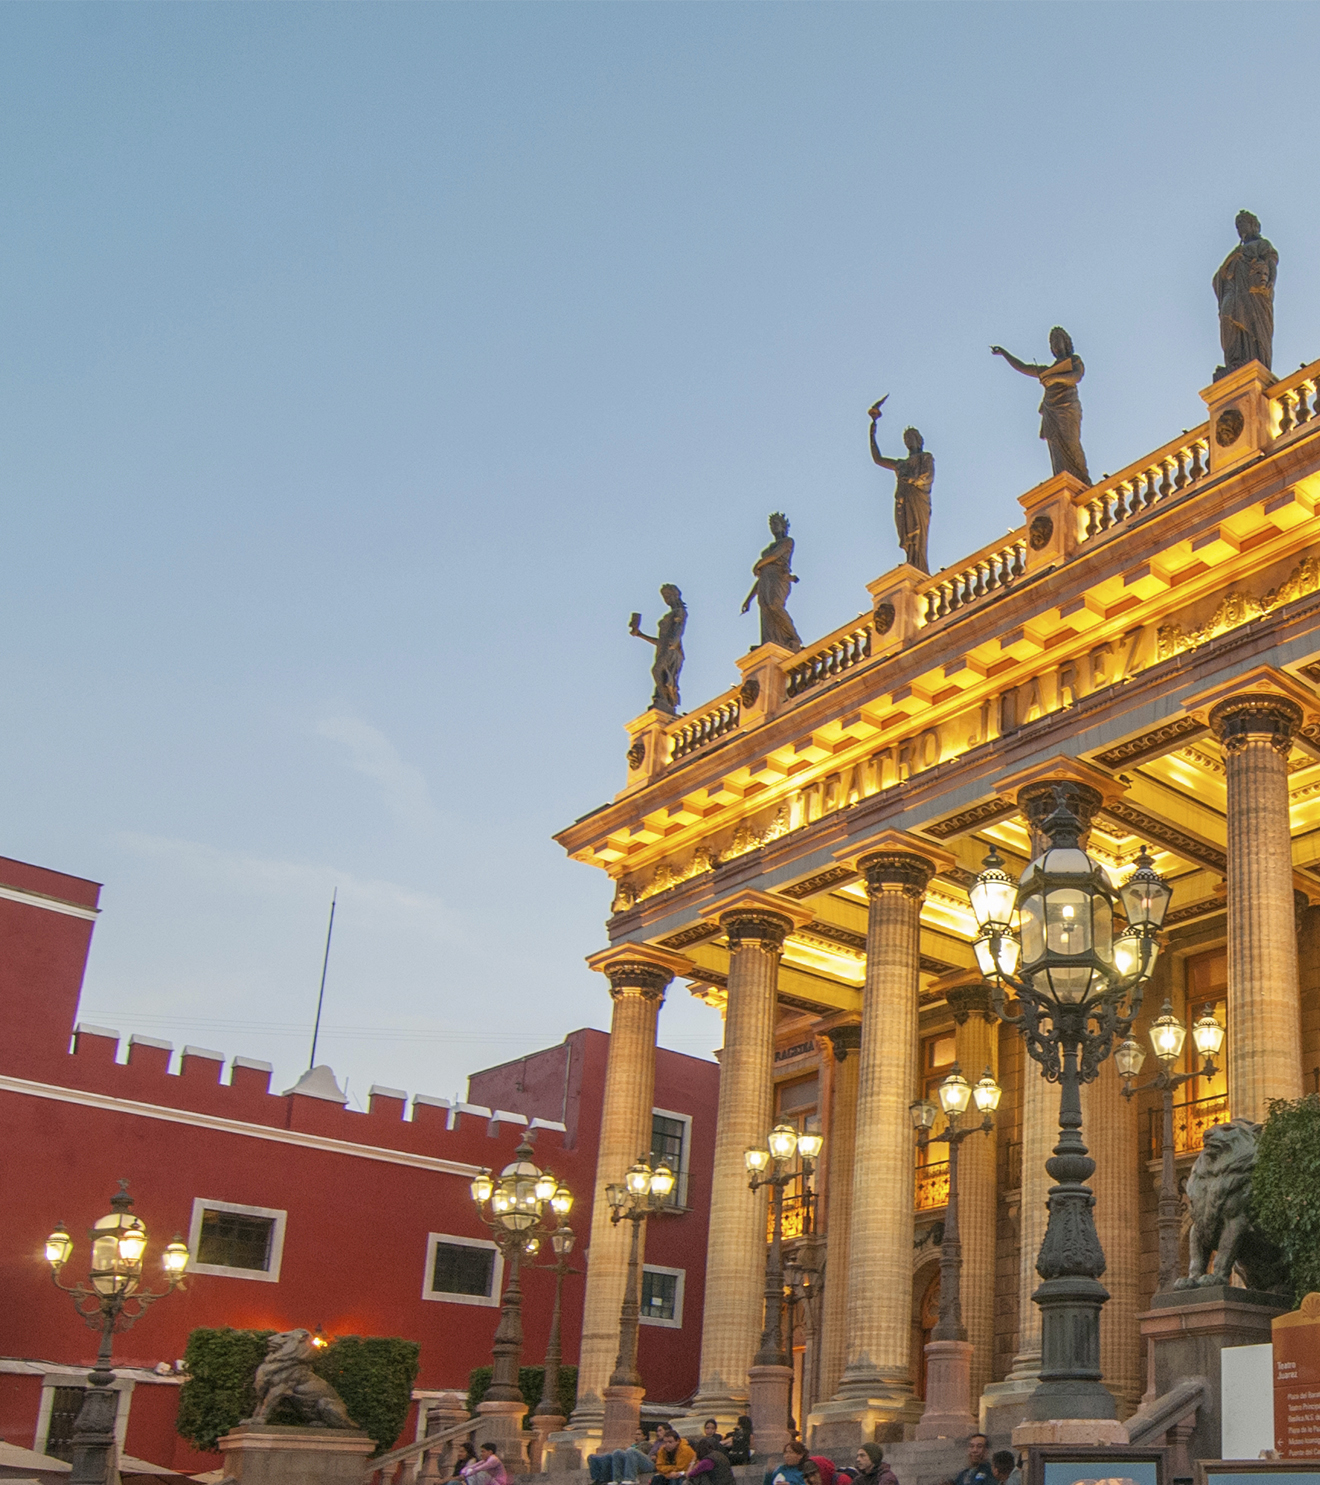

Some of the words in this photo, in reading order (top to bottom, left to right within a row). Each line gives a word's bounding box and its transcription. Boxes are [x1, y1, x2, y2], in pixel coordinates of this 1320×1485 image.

[793, 729, 942, 828] TEATRO
[967, 625, 1146, 747] JUAREZ
[774, 1041, 814, 1062] RAGEDIA
[1277, 1361, 1297, 1370] Teatro
